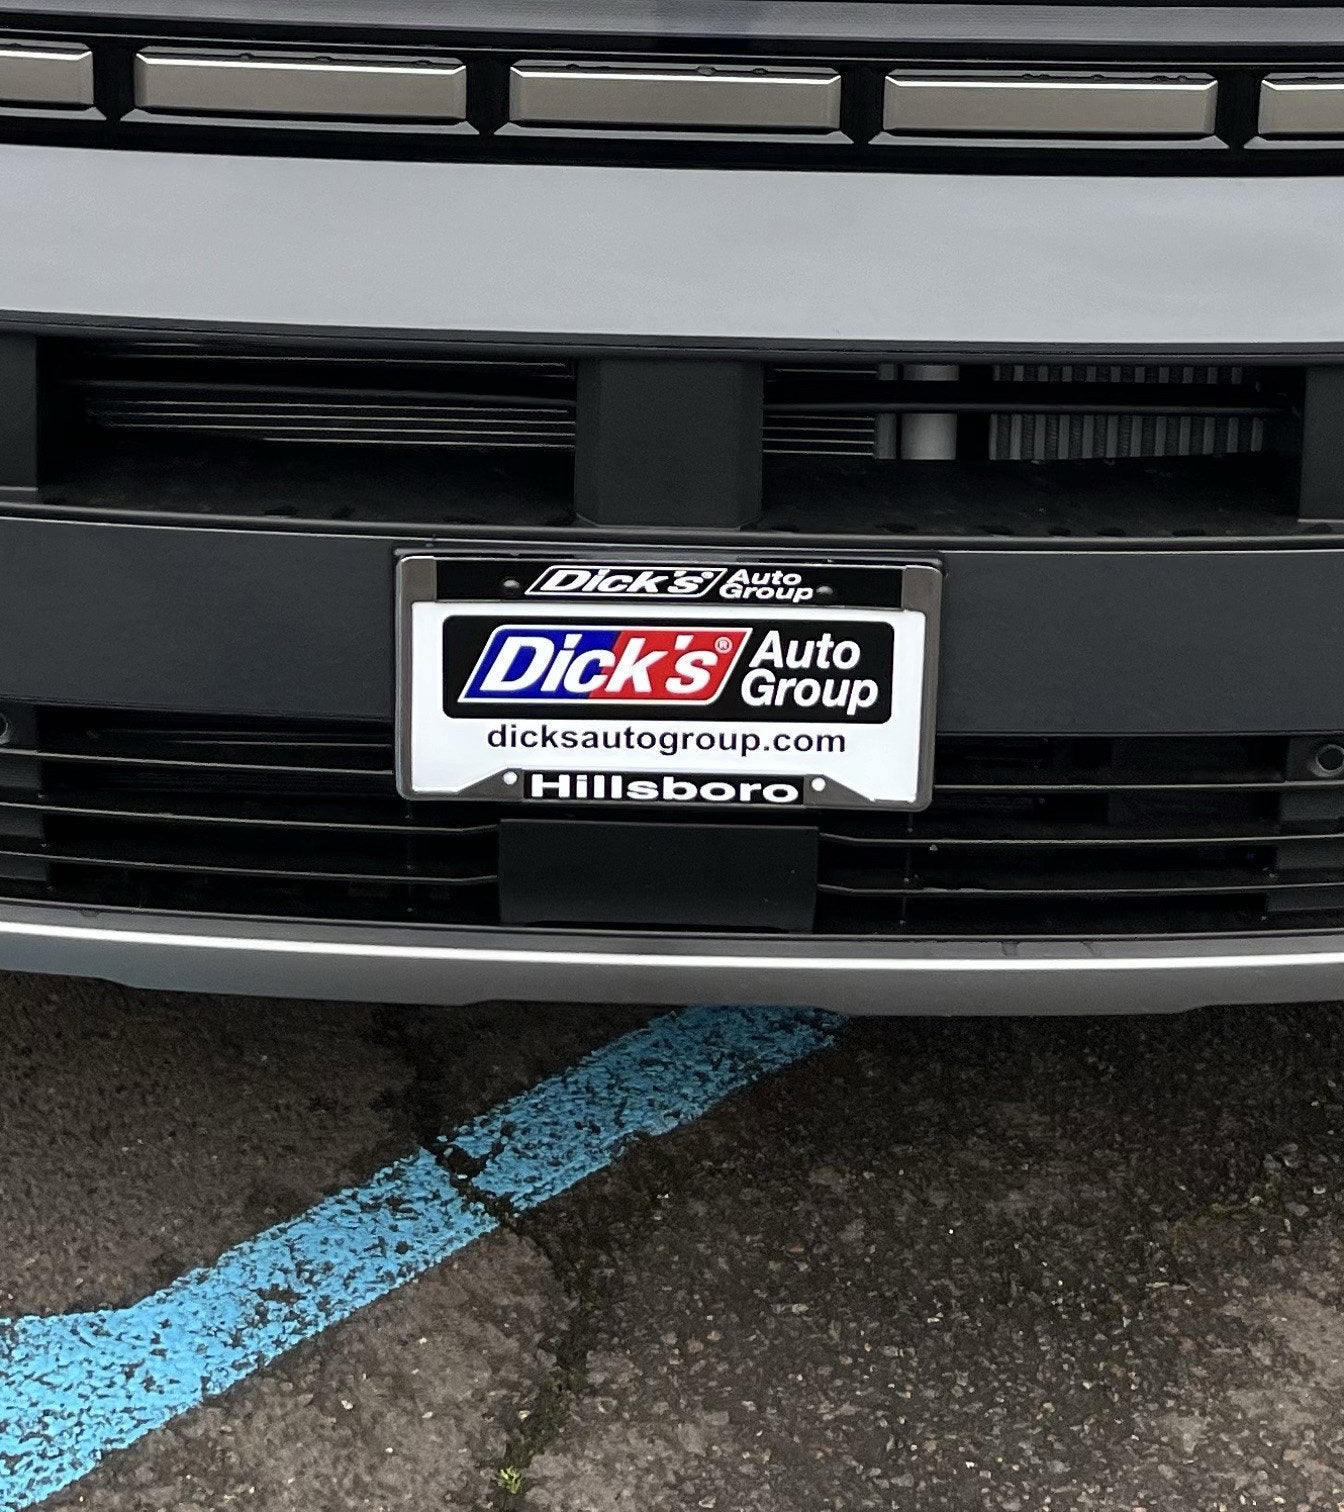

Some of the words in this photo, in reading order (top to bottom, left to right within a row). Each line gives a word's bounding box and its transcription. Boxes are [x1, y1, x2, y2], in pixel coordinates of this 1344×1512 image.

[540, 569, 706, 594] Dick's
[726, 569, 802, 586] Auto
[719, 585, 815, 603] Group
[479, 633, 713, 695] Dick's
[749, 630, 861, 670] Auto
[741, 669, 879, 716] Group
[487, 724, 846, 758] dicksautogroup.com
[530, 774, 799, 803] Hillsboro
